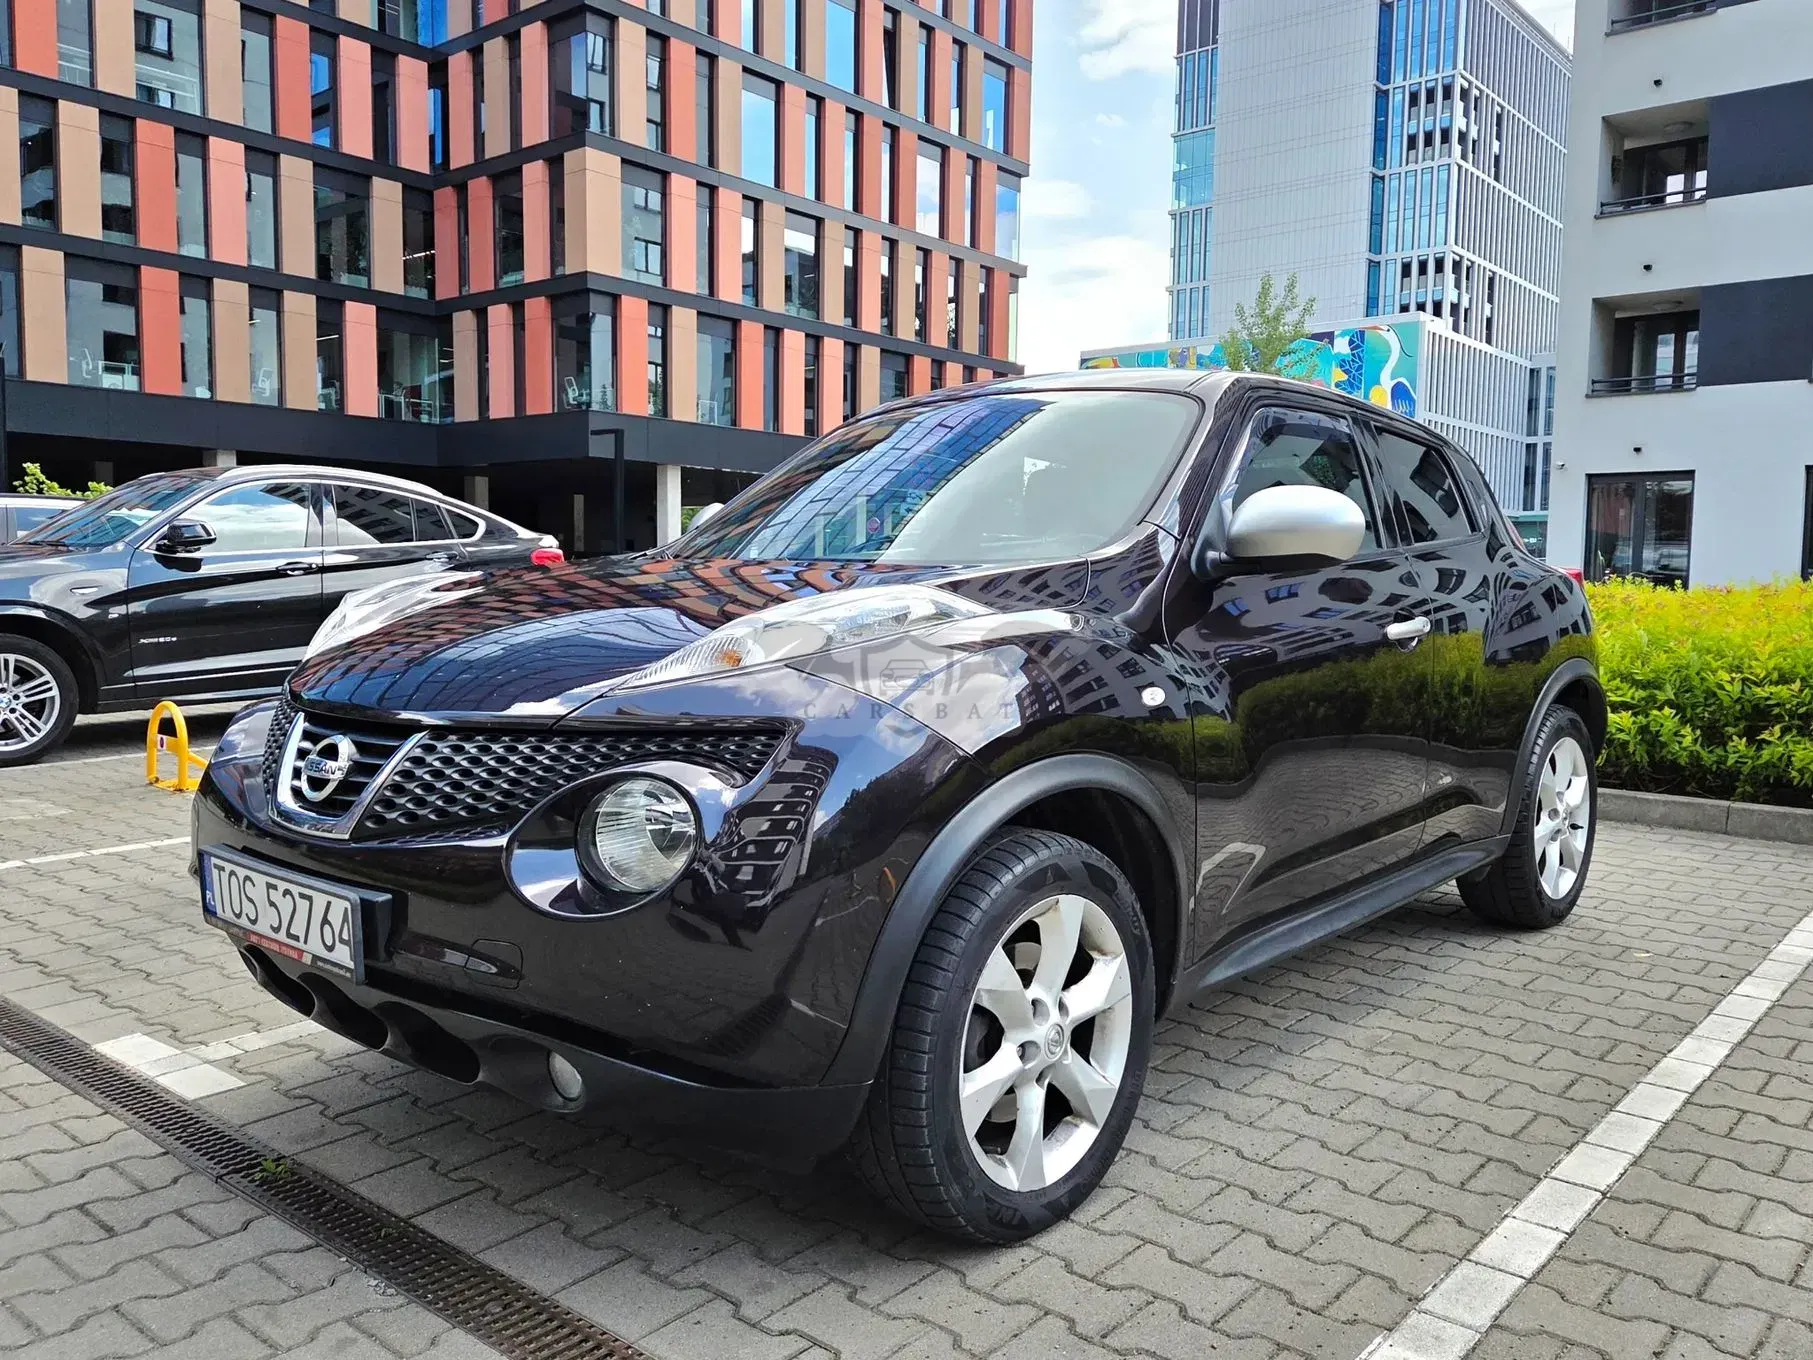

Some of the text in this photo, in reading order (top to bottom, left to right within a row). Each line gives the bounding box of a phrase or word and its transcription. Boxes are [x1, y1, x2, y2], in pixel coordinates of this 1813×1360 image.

[305, 758, 338, 775] SSAN
[213, 863, 354, 963] TOS 52764
